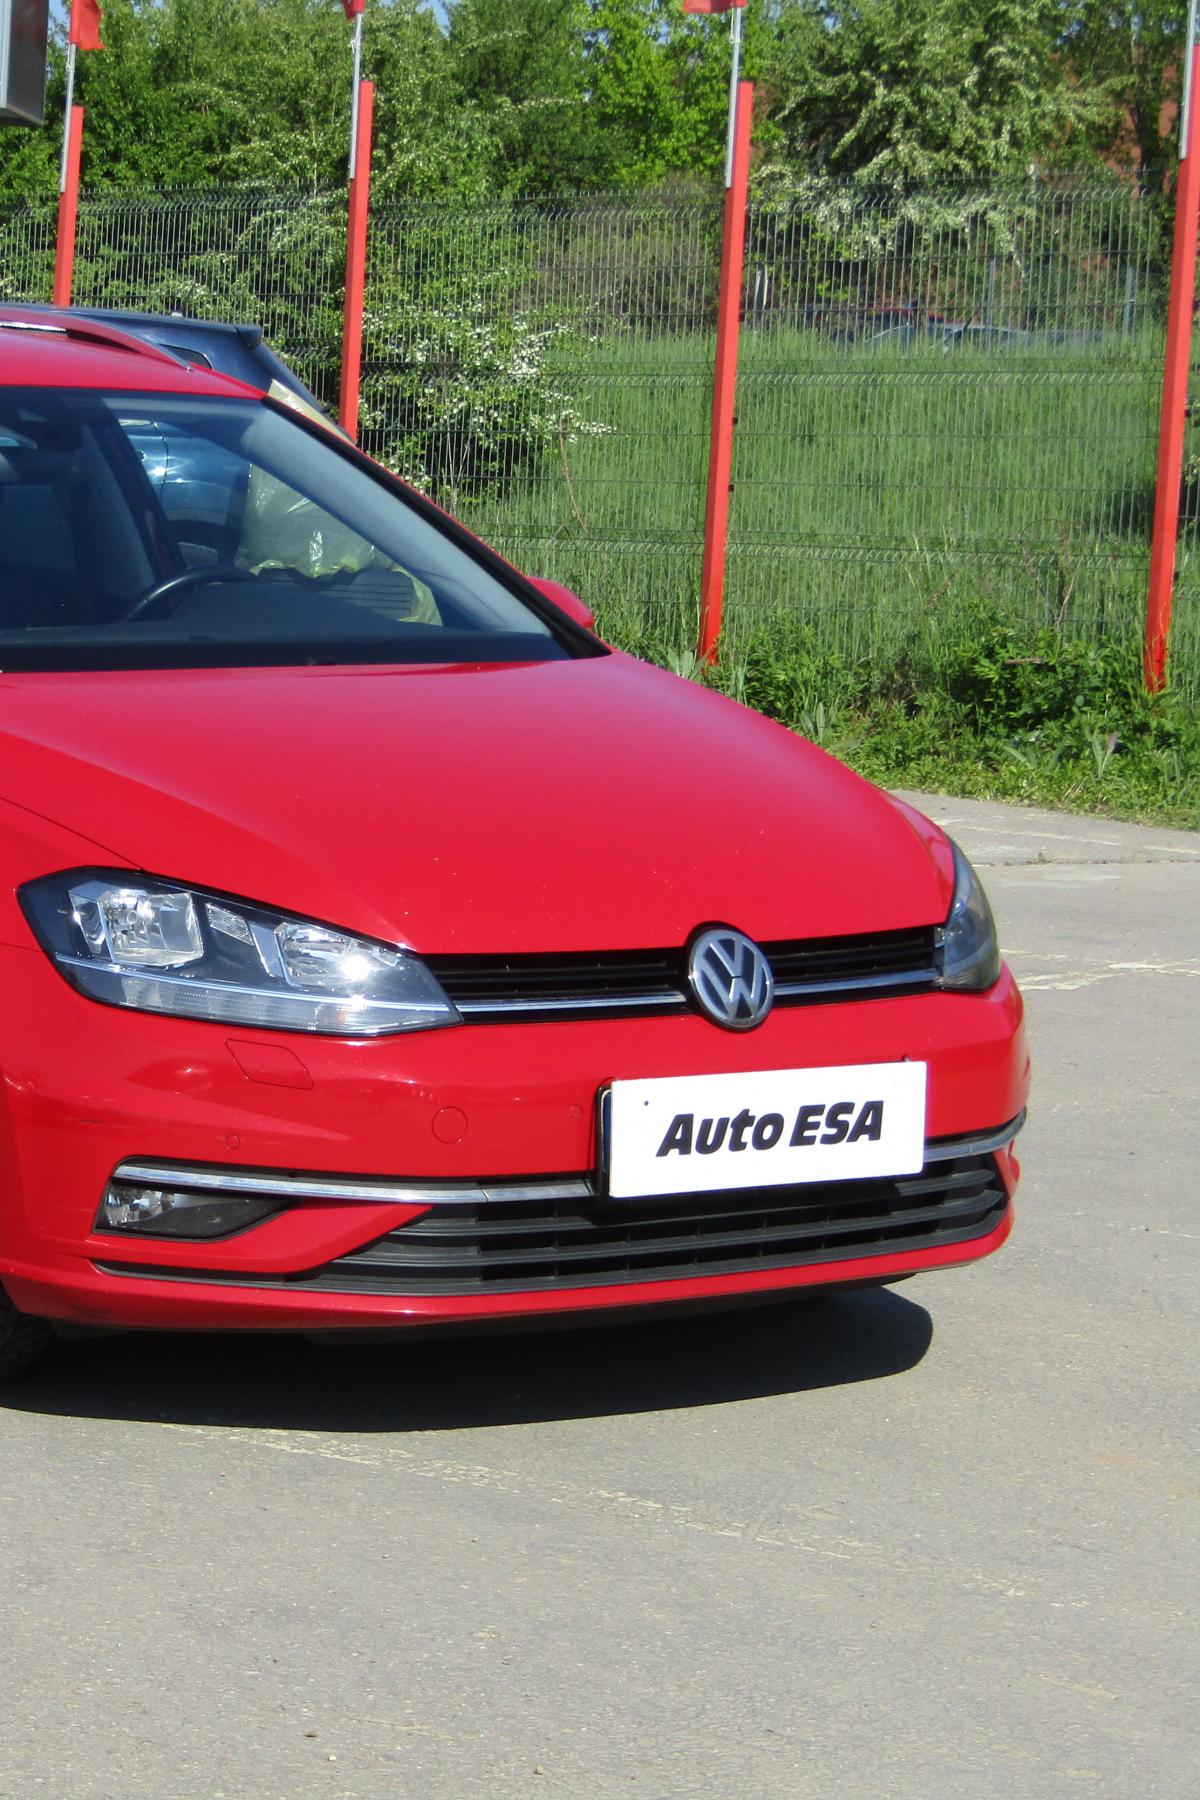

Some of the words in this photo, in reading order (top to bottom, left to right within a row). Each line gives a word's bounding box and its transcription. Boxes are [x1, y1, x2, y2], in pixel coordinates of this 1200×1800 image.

[689, 928, 775, 1030] VW
[656, 1108, 785, 1158] Auto
[789, 1100, 884, 1147] ESA
